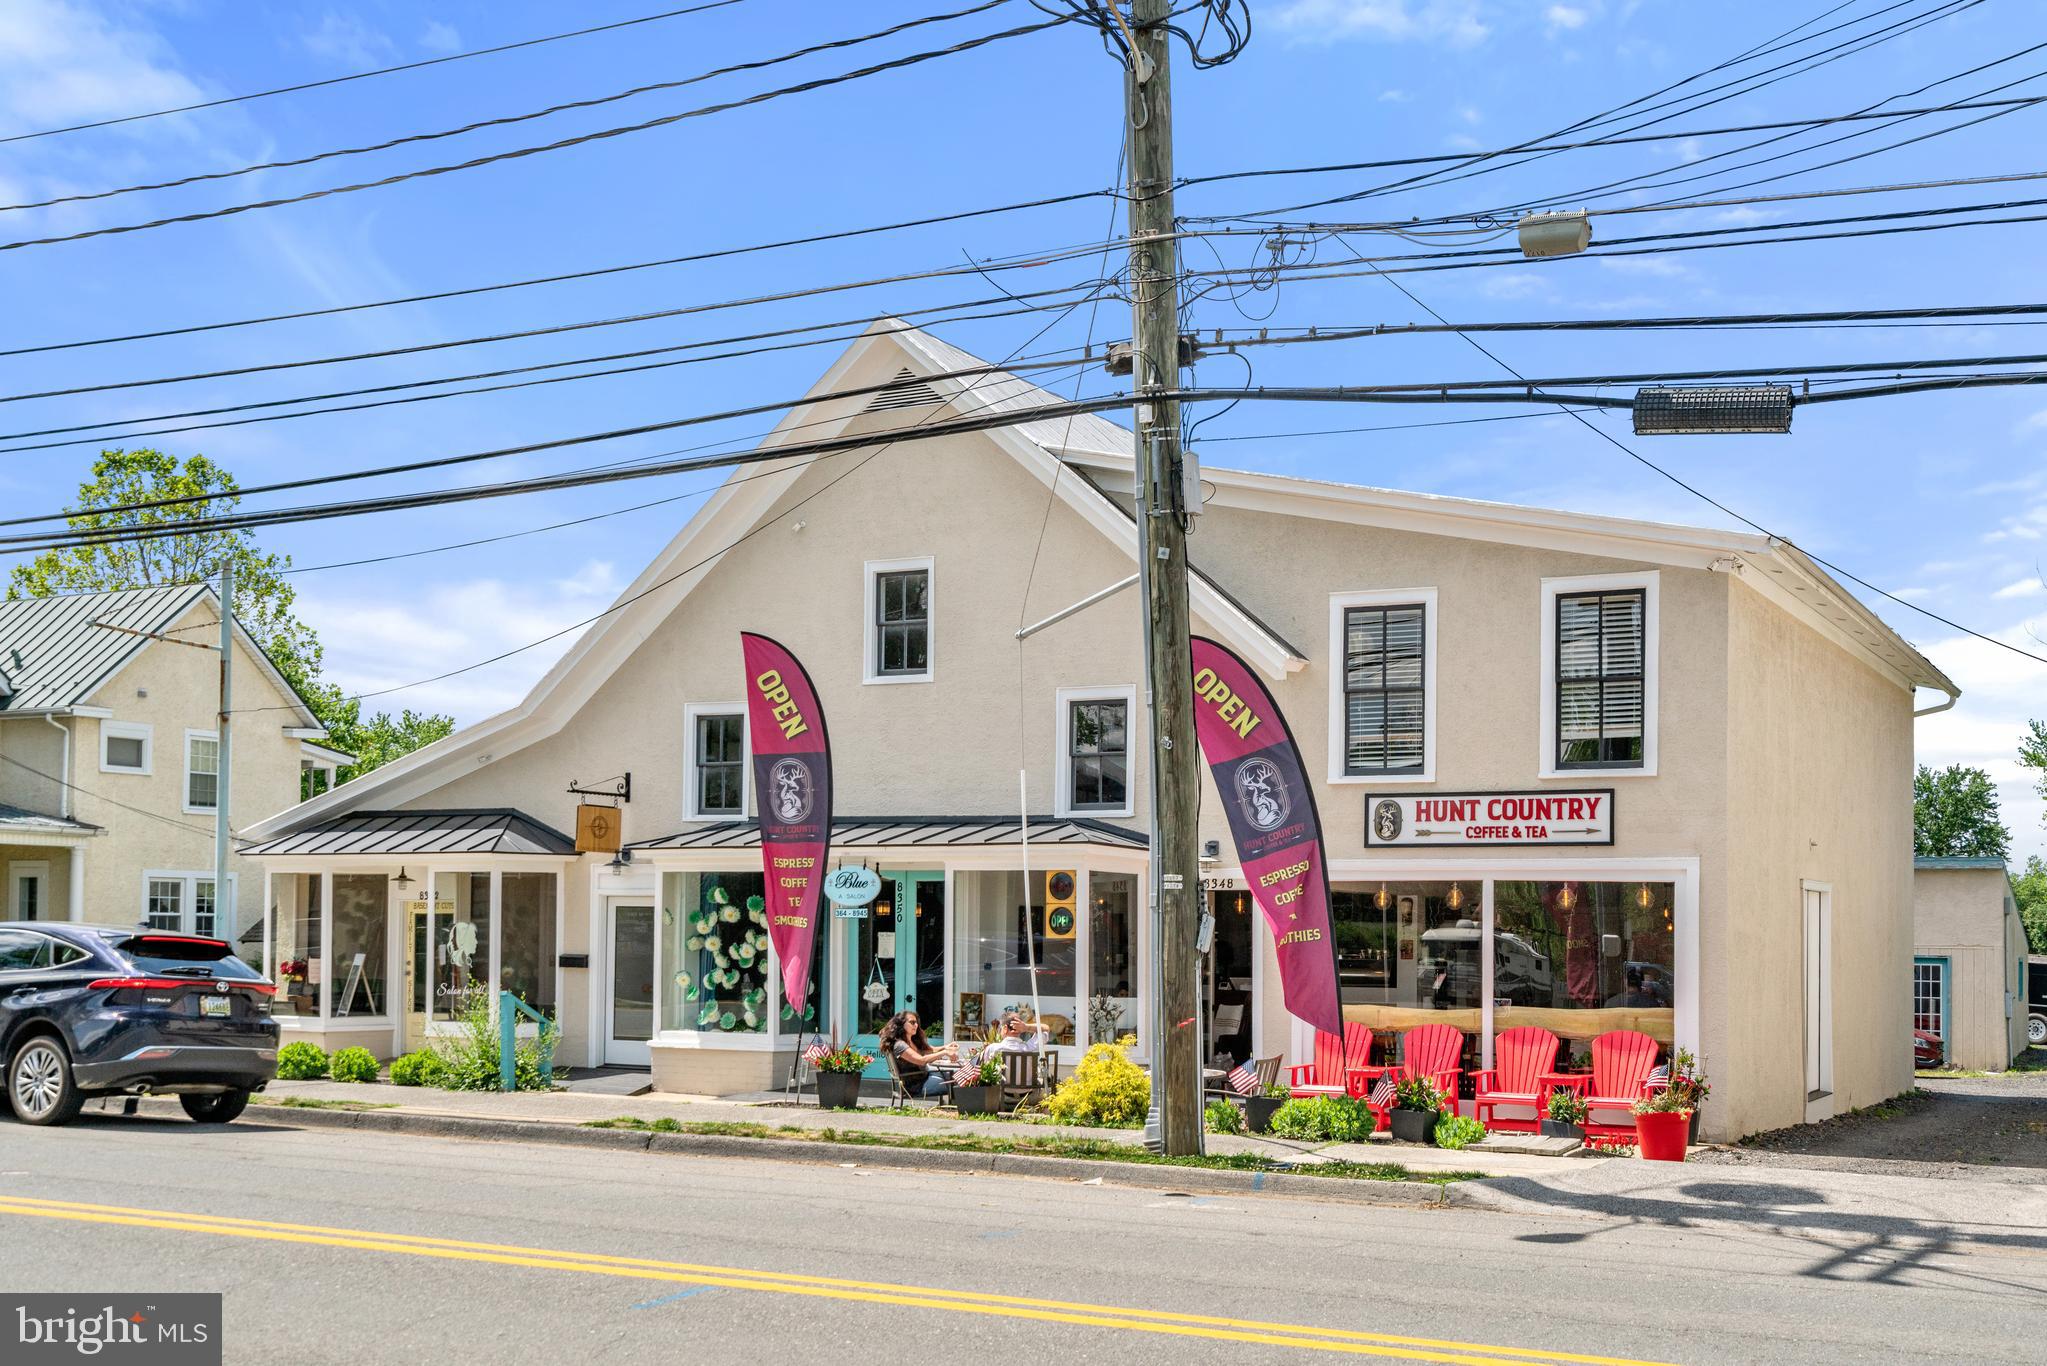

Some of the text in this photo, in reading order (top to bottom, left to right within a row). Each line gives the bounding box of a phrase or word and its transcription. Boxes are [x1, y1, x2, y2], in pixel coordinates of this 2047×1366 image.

[756, 669, 808, 741] OPEN
[1193, 666, 1261, 740] OPEN
[1415, 797, 1602, 822] HUNT COUNTRY
[1465, 825, 1548, 839] COFFEE & TEA
[834, 871, 869, 889] Blue
[835, 909, 847, 917] 364
[866, 1050, 886, 1059] Hello
